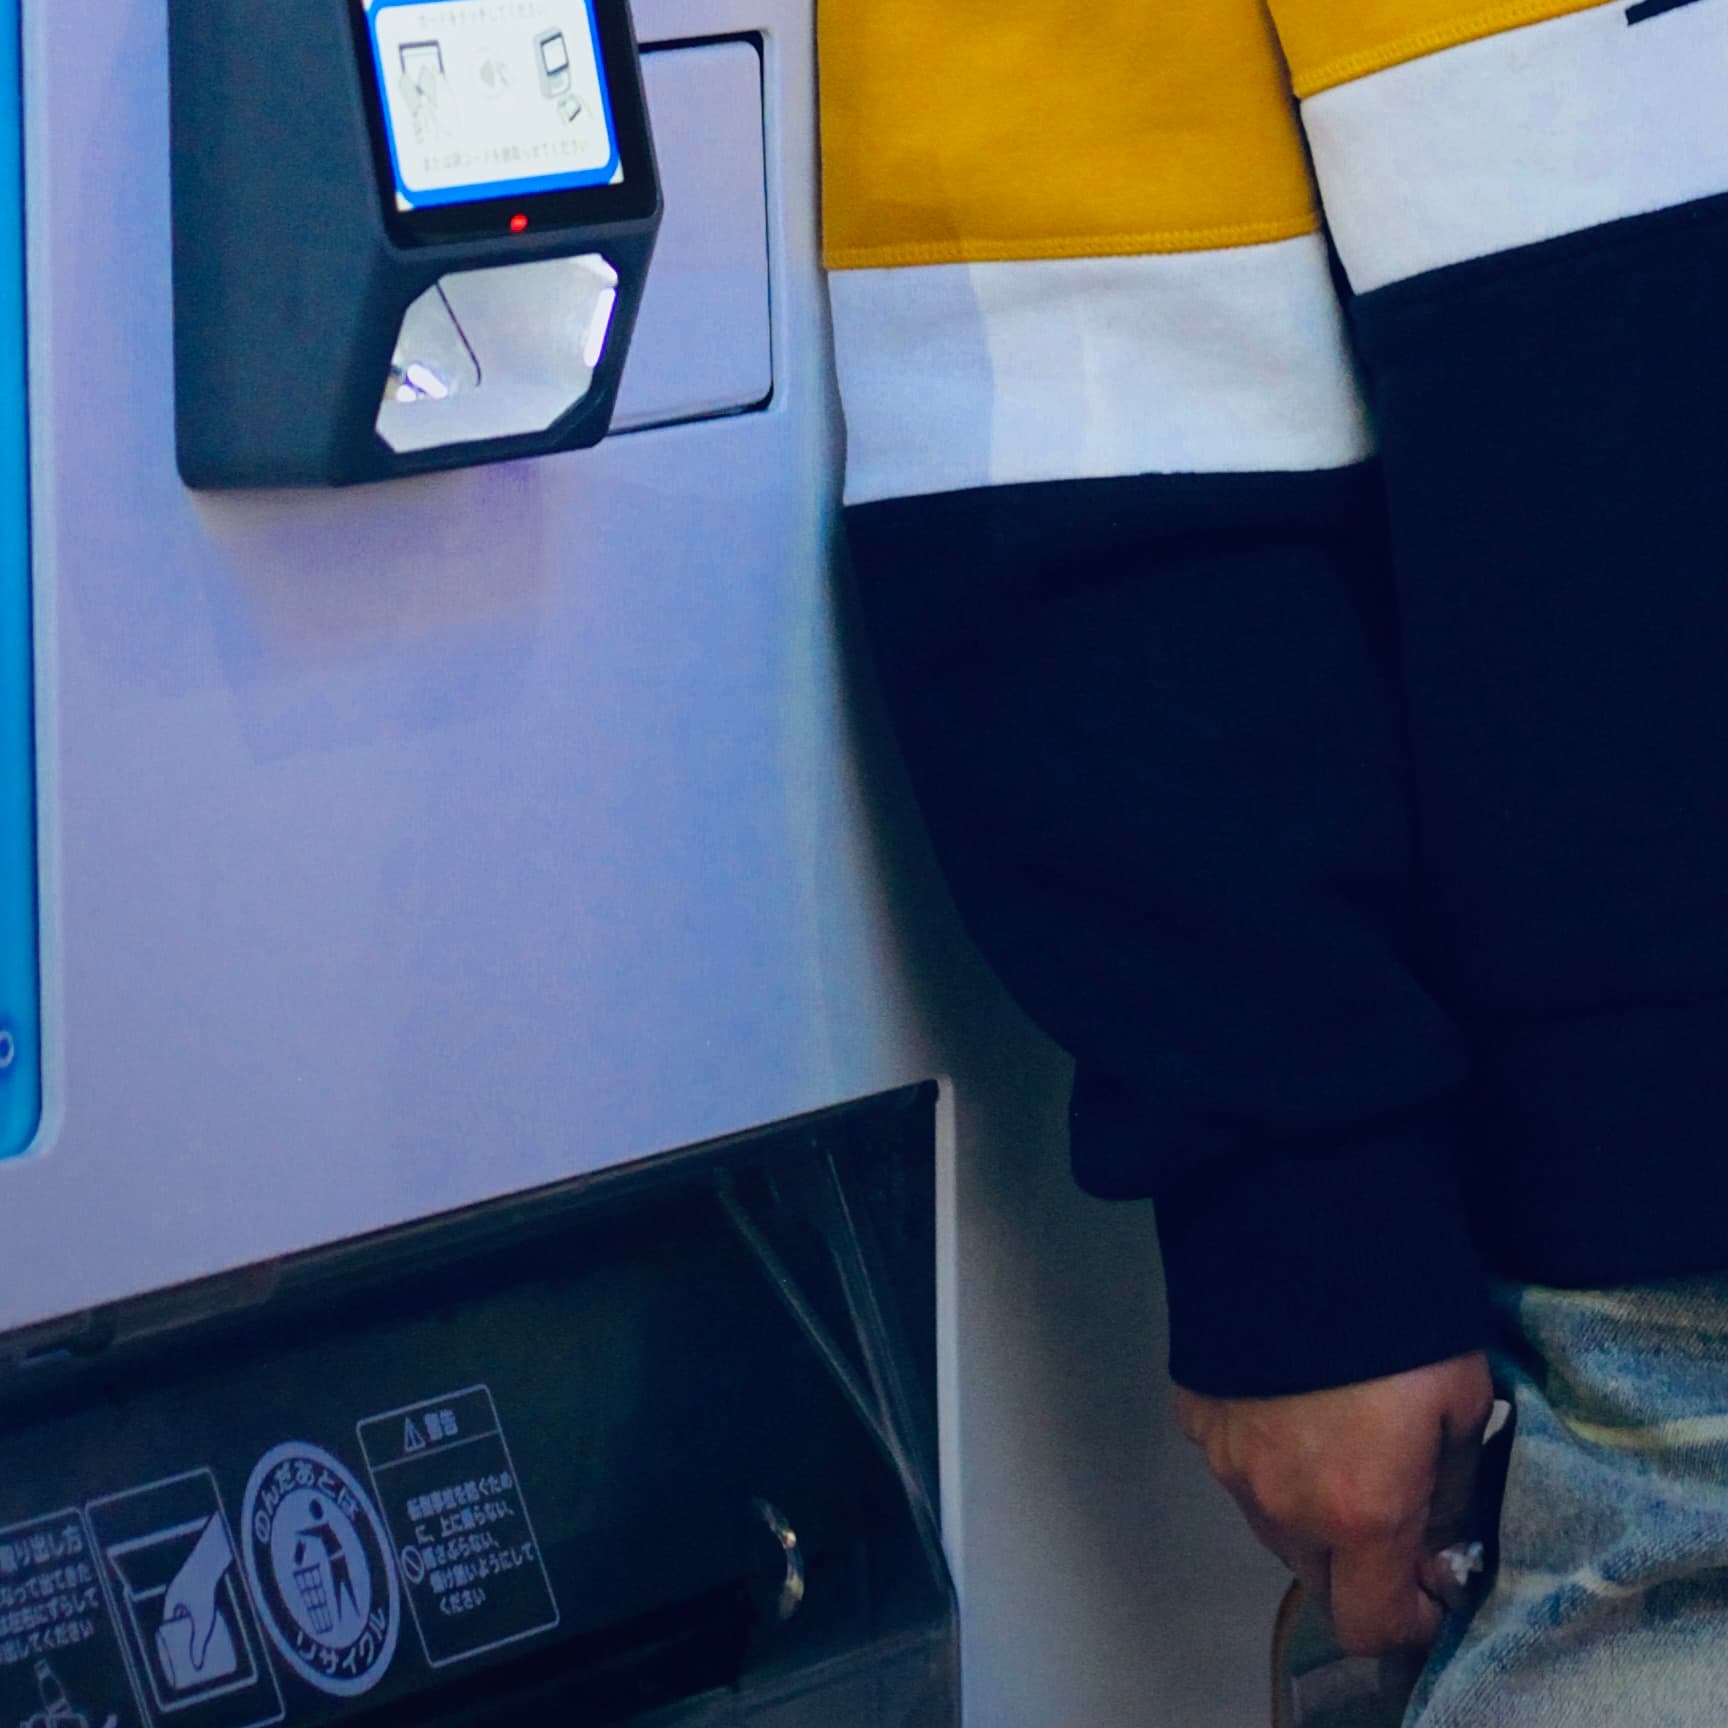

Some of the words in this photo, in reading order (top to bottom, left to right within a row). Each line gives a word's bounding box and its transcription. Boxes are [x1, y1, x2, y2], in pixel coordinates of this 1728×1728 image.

[254, 1458, 360, 1545] のんだあとは
[439, 1586, 487, 1616] ください
[296, 1607, 388, 1674] リサイクル
